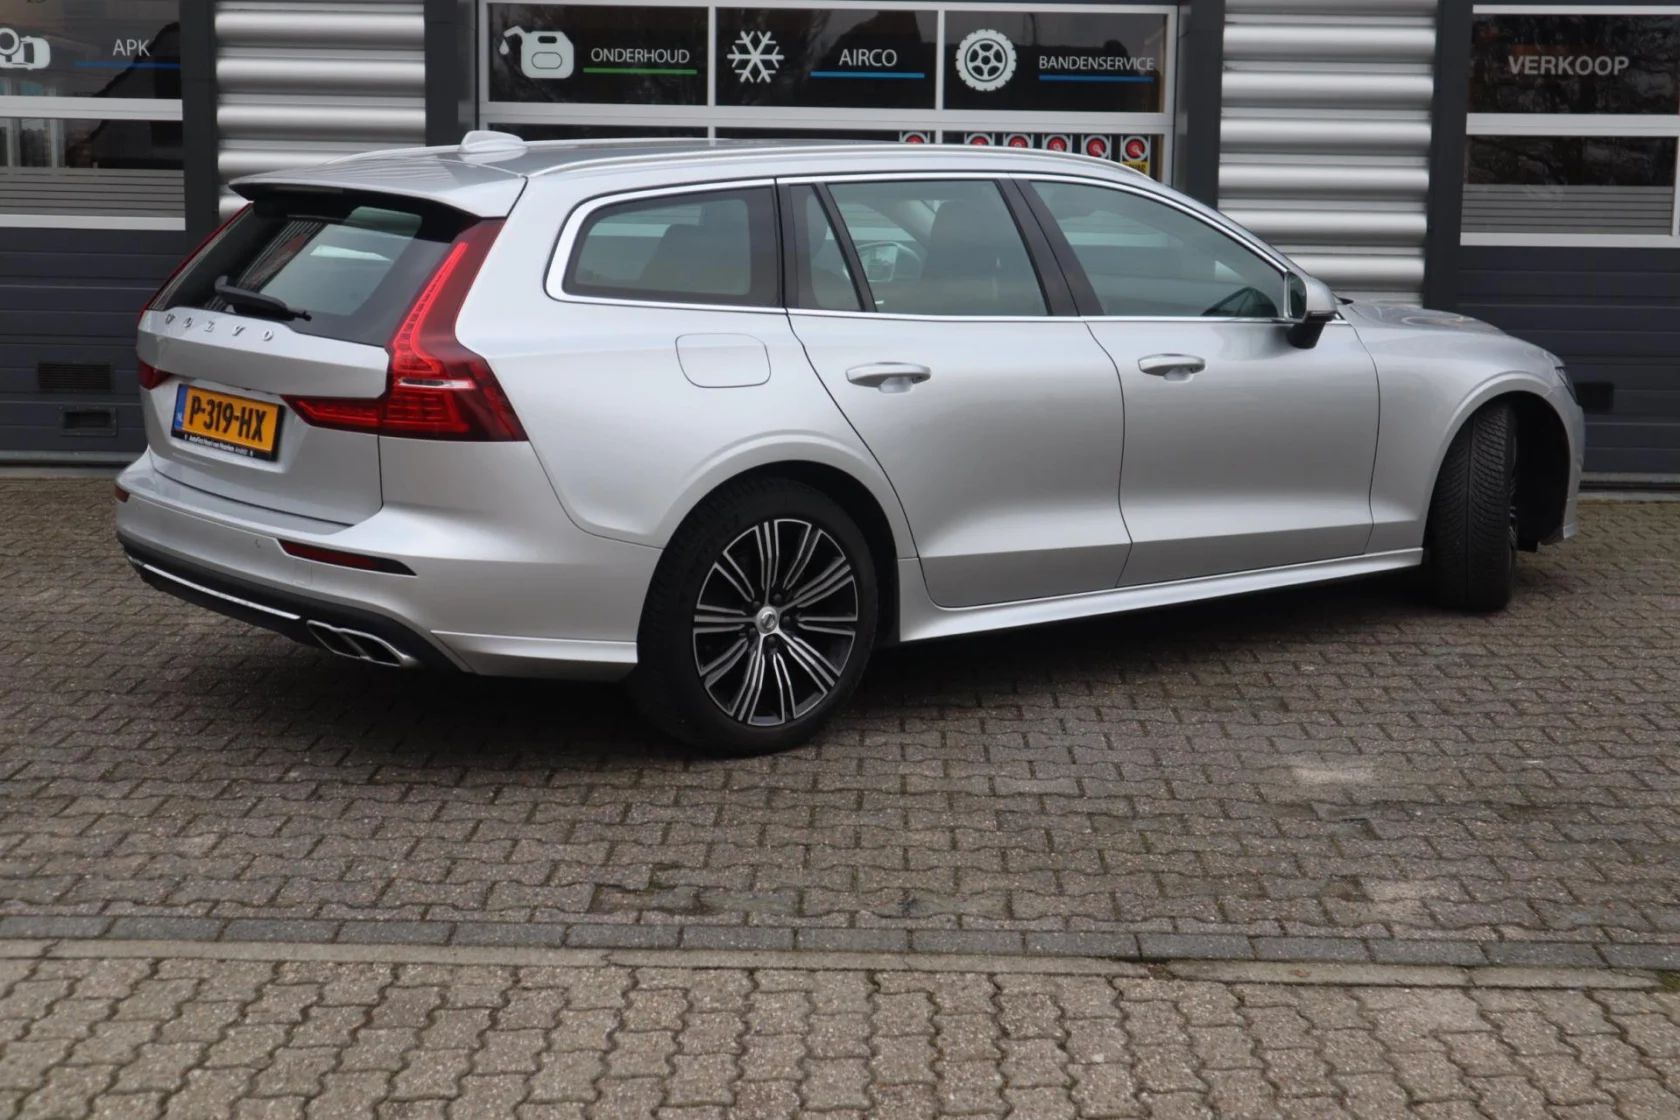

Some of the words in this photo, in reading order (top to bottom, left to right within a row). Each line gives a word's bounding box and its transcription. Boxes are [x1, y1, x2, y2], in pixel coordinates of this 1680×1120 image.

[112, 38, 151, 57] APK
[590, 47, 691, 64] ONDERHOUD
[838, 48, 898, 67] AIRCO
[1038, 55, 1155, 71] BANDENSERVICE
[1507, 55, 1630, 76] VERKOOP
[164, 303, 275, 342] VOLVO
[188, 395, 267, 443] P-319-HX
